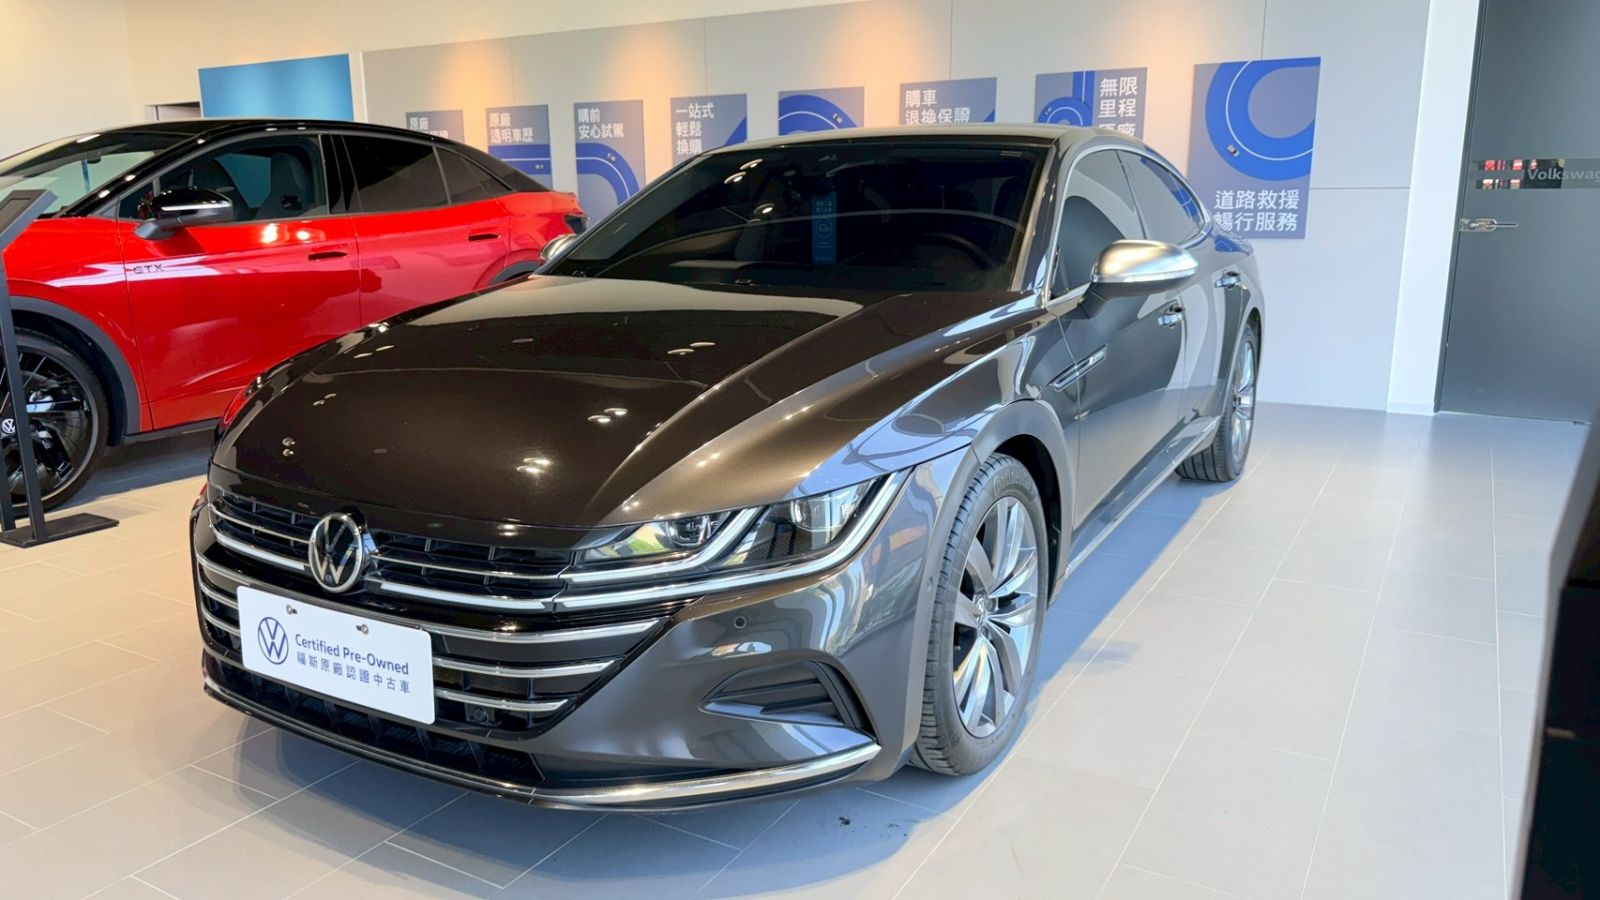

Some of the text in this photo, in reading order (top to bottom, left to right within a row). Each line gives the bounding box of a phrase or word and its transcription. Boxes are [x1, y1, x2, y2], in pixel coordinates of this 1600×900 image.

[1100, 76, 1137, 97] 無限
[905, 88, 937, 108] 購車
[578, 108, 600, 123] 購前
[675, 102, 715, 119] 一站式
[905, 107, 970, 125] 退換保證
[1098, 99, 1136, 118] 里程
[579, 123, 624, 139] 安心試駕
[676, 120, 702, 137] 輕鬆
[1214, 189, 1300, 210] 道路救援
[1213, 211, 1299, 232] 暢行服務
[133, 264, 164, 275] GTX
[295, 633, 409, 675] Certified Pre-Owned
[297, 650, 411, 694] 福斯原廠認證中古車
